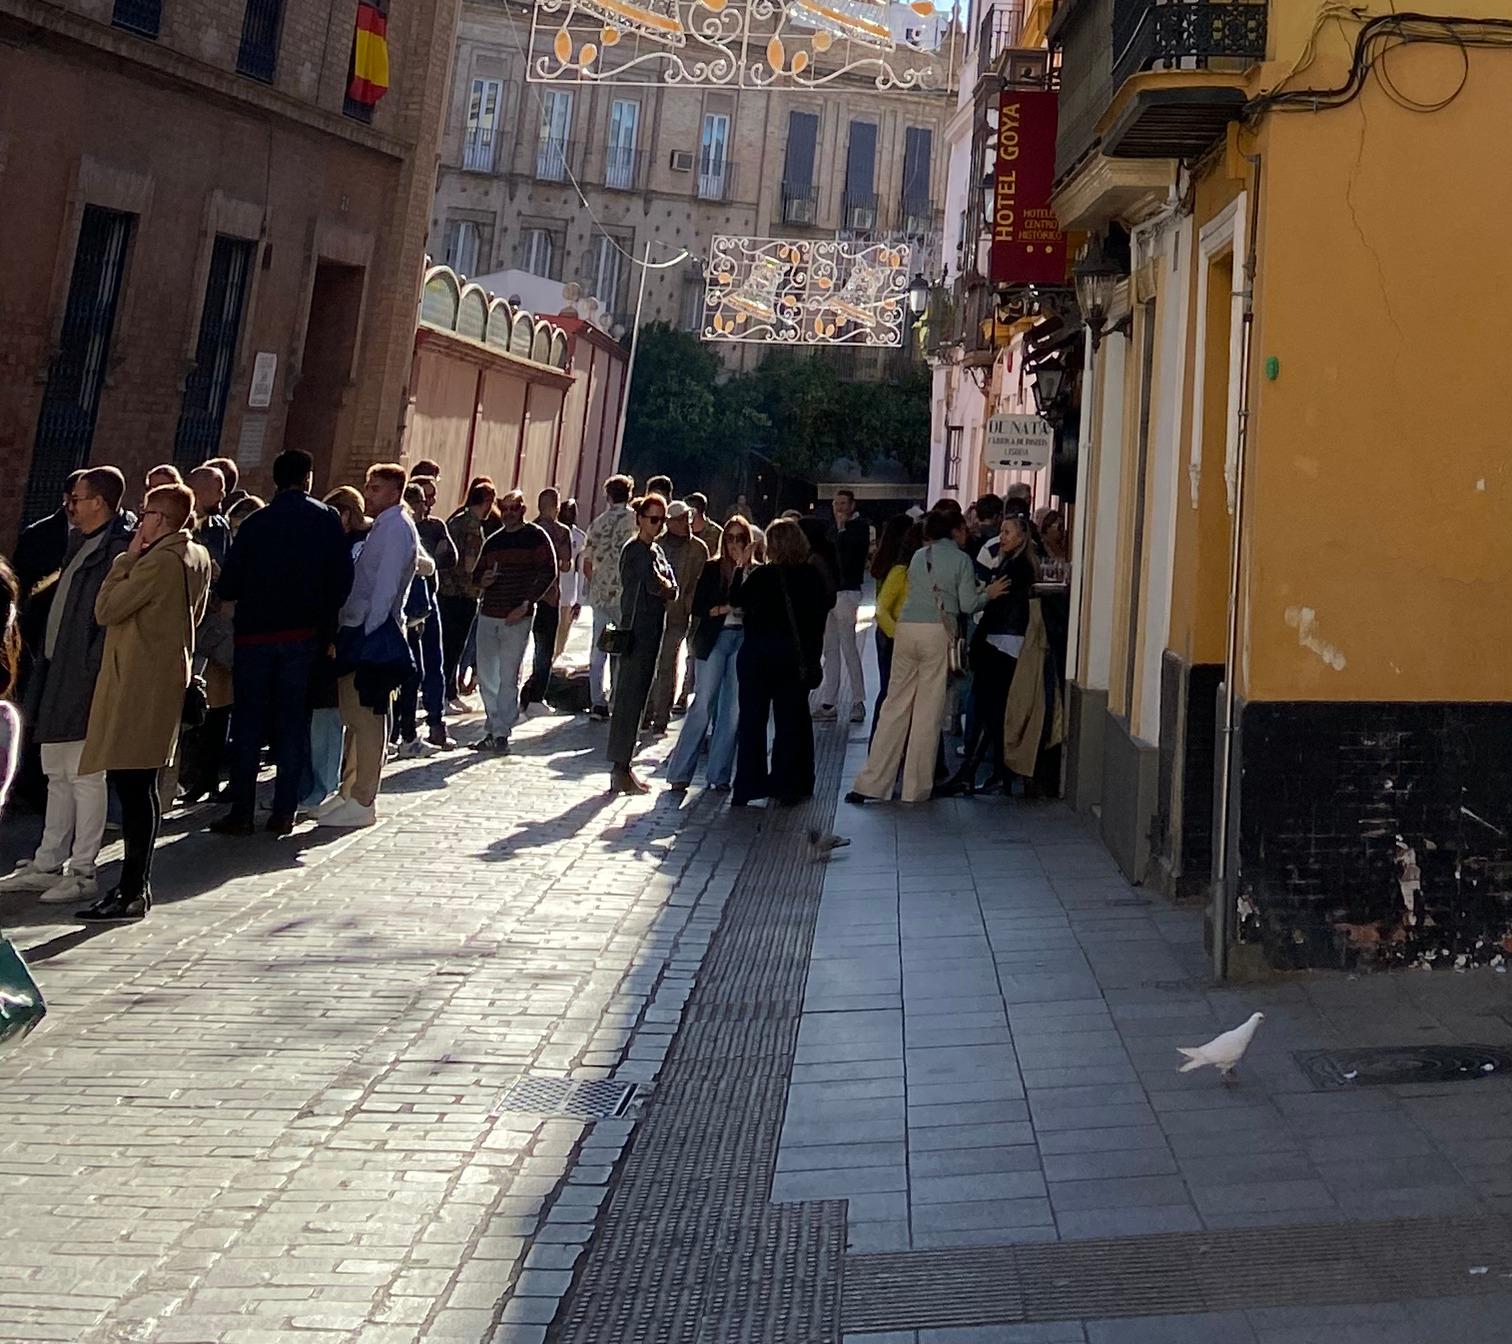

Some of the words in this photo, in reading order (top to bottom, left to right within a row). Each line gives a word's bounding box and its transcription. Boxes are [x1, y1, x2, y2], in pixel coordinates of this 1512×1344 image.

[999, 103, 1021, 161] GOYA
[995, 169, 1017, 242] HOTEL
[1024, 219, 1058, 230] CENTRO
[1010, 420, 1050, 435] NATA
